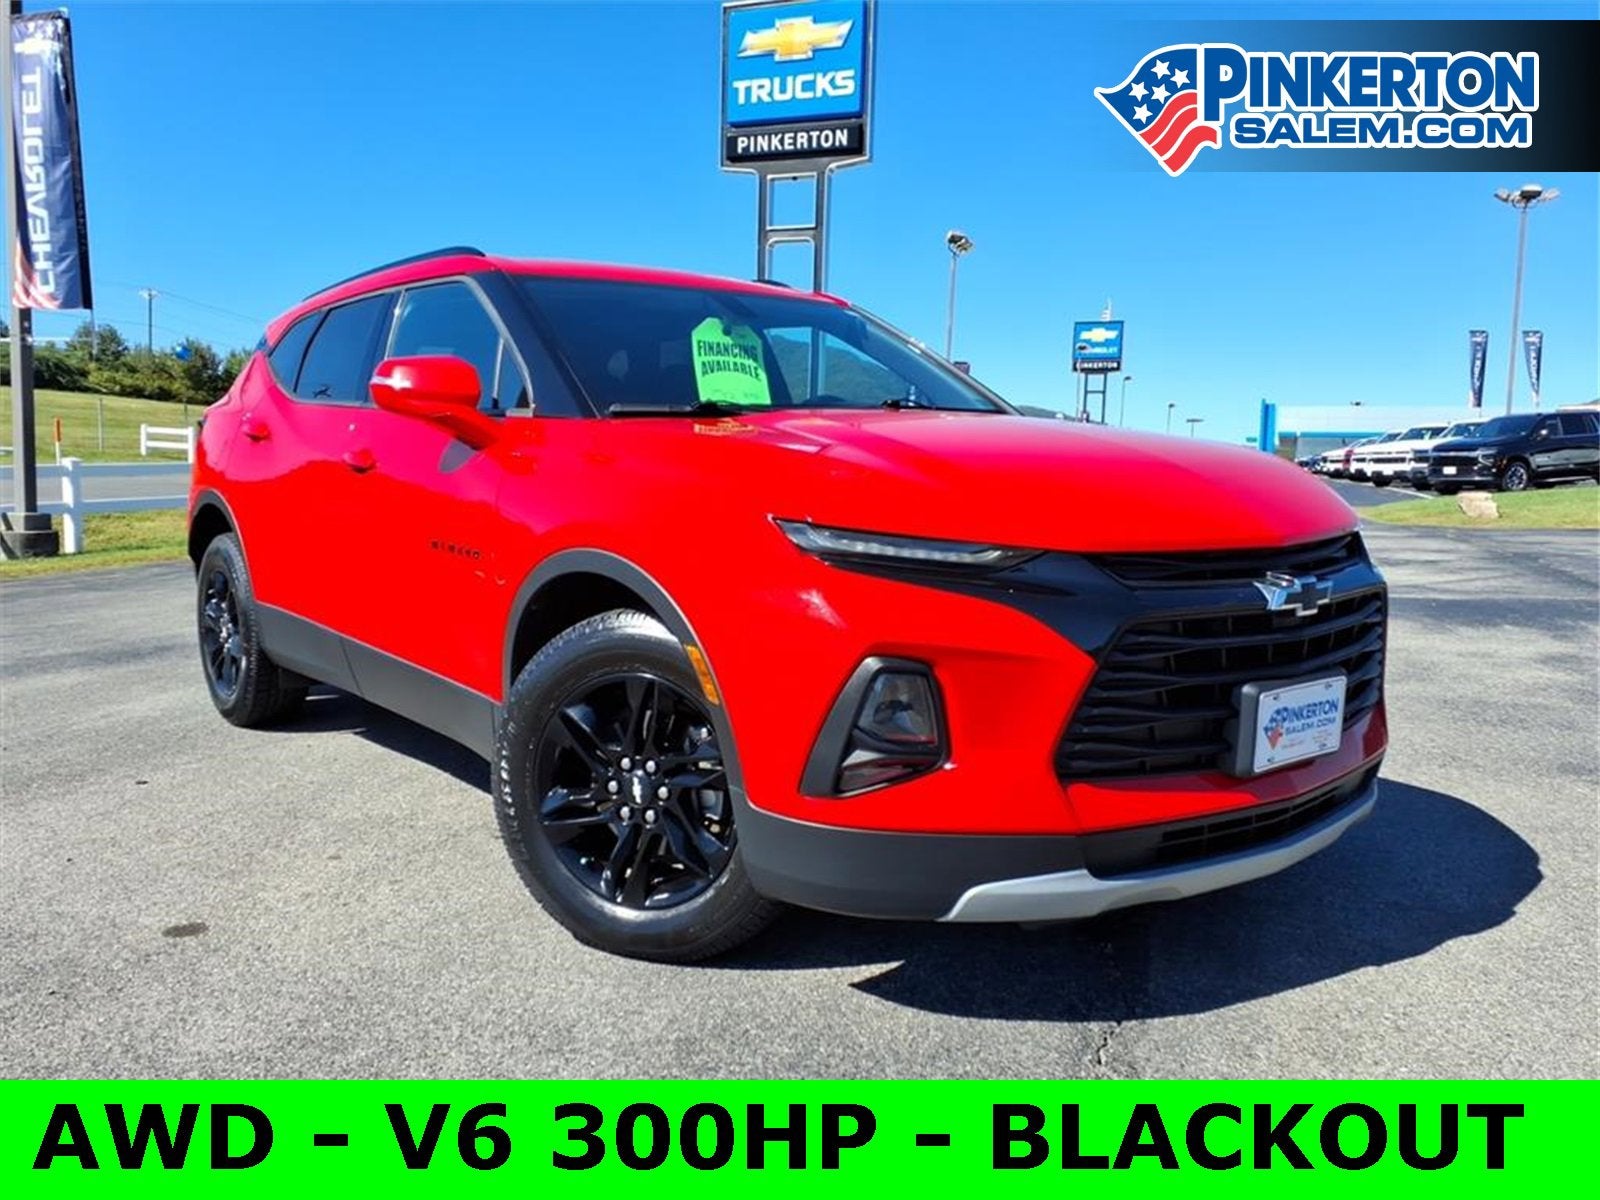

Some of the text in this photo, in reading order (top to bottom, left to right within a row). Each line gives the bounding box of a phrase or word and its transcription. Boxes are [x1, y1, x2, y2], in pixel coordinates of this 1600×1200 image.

[732, 69, 856, 105] TRUCKS
[737, 128, 848, 154] PINKERTON
[696, 339, 759, 363] FINANCING
[701, 359, 762, 382] AVAILABLE
[1280, 698, 1340, 723] PINKERTON
